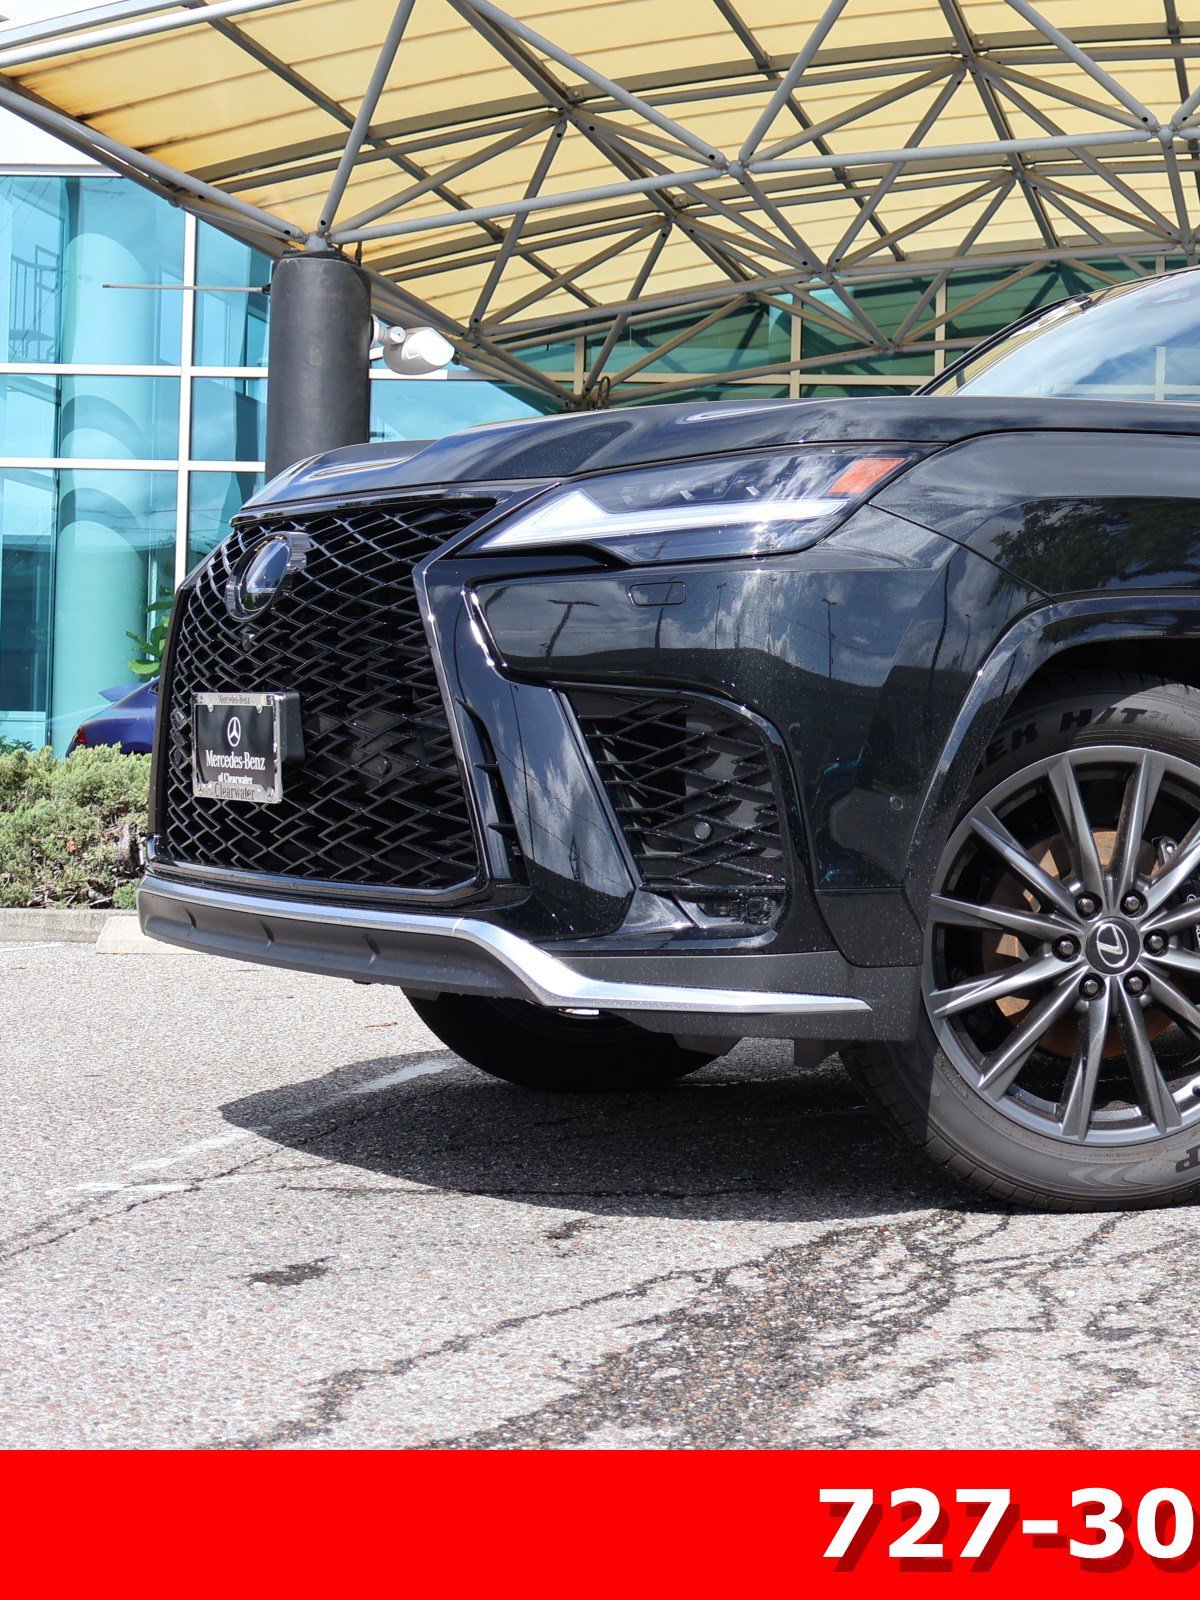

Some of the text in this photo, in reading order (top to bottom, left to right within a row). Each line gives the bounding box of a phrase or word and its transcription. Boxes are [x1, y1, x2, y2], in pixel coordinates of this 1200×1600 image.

[974, 721, 1039, 776] EK
[1059, 706, 1148, 732] H/T
[205, 749, 266, 771] Mercedes-Benz
[217, 772, 254, 784] of Clearwater
[214, 782, 256, 800] Clearwater
